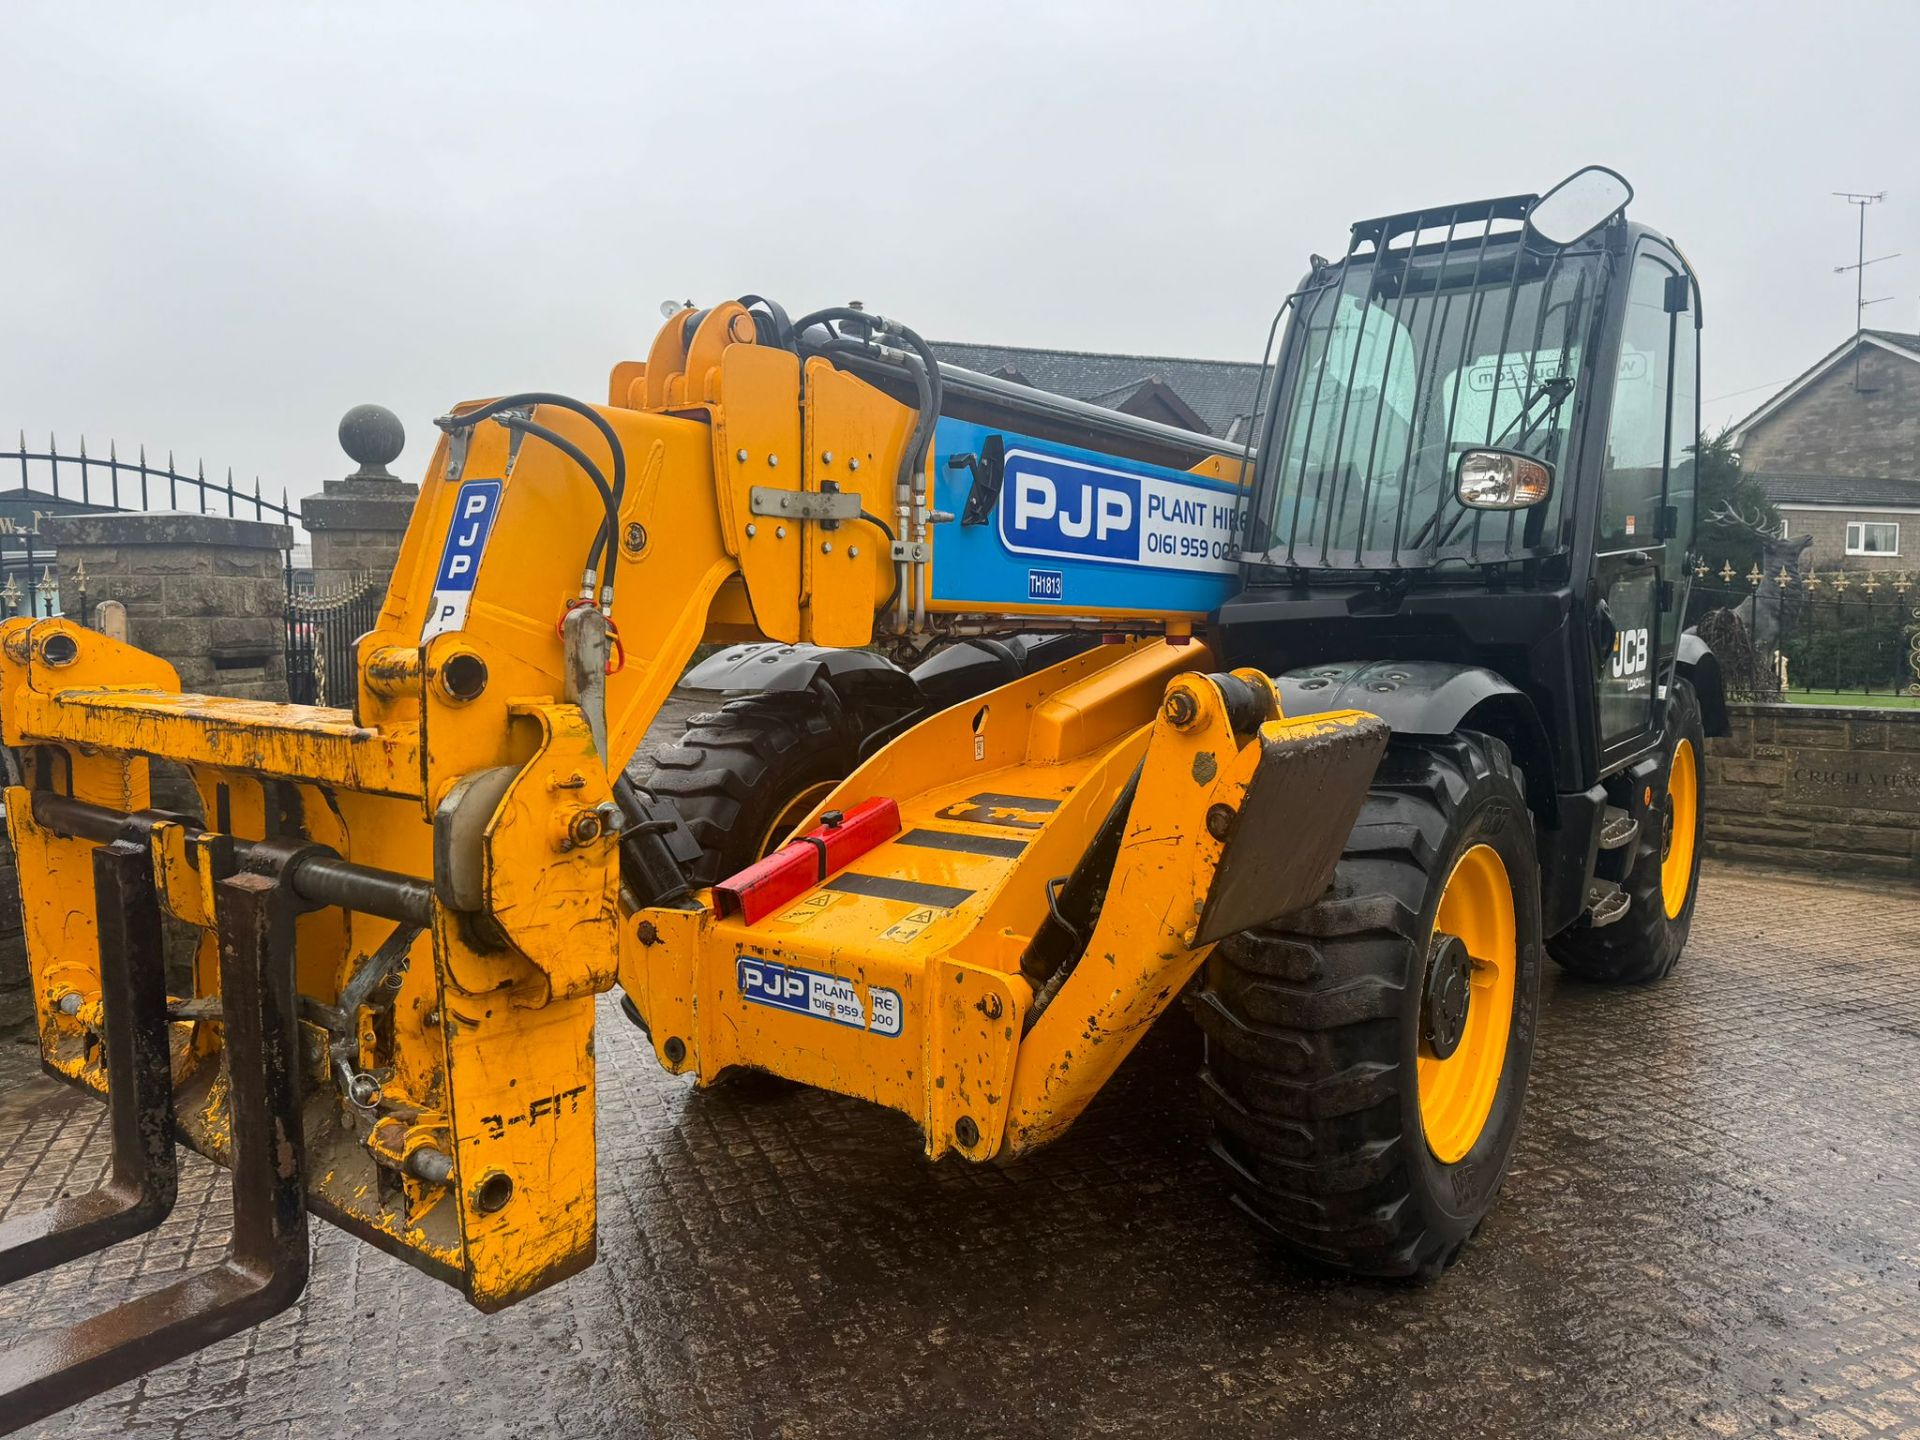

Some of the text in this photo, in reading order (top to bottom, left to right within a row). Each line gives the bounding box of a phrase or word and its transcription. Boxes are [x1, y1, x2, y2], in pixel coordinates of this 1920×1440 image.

[1015, 472, 1132, 541] PJP
[1148, 493, 1207, 527] PLANT
[448, 495, 487, 579] PJP
[1147, 532, 1176, 556] 0161
[1181, 536, 1208, 558] 959
[1030, 575, 1061, 595] TH1813
[1613, 628, 1648, 678] JCB
[1794, 768, 1859, 785] CRICH
[743, 967, 804, 998] PJP
[814, 982, 892, 1011] PLANT IRE
[813, 998, 834, 1013] 016
